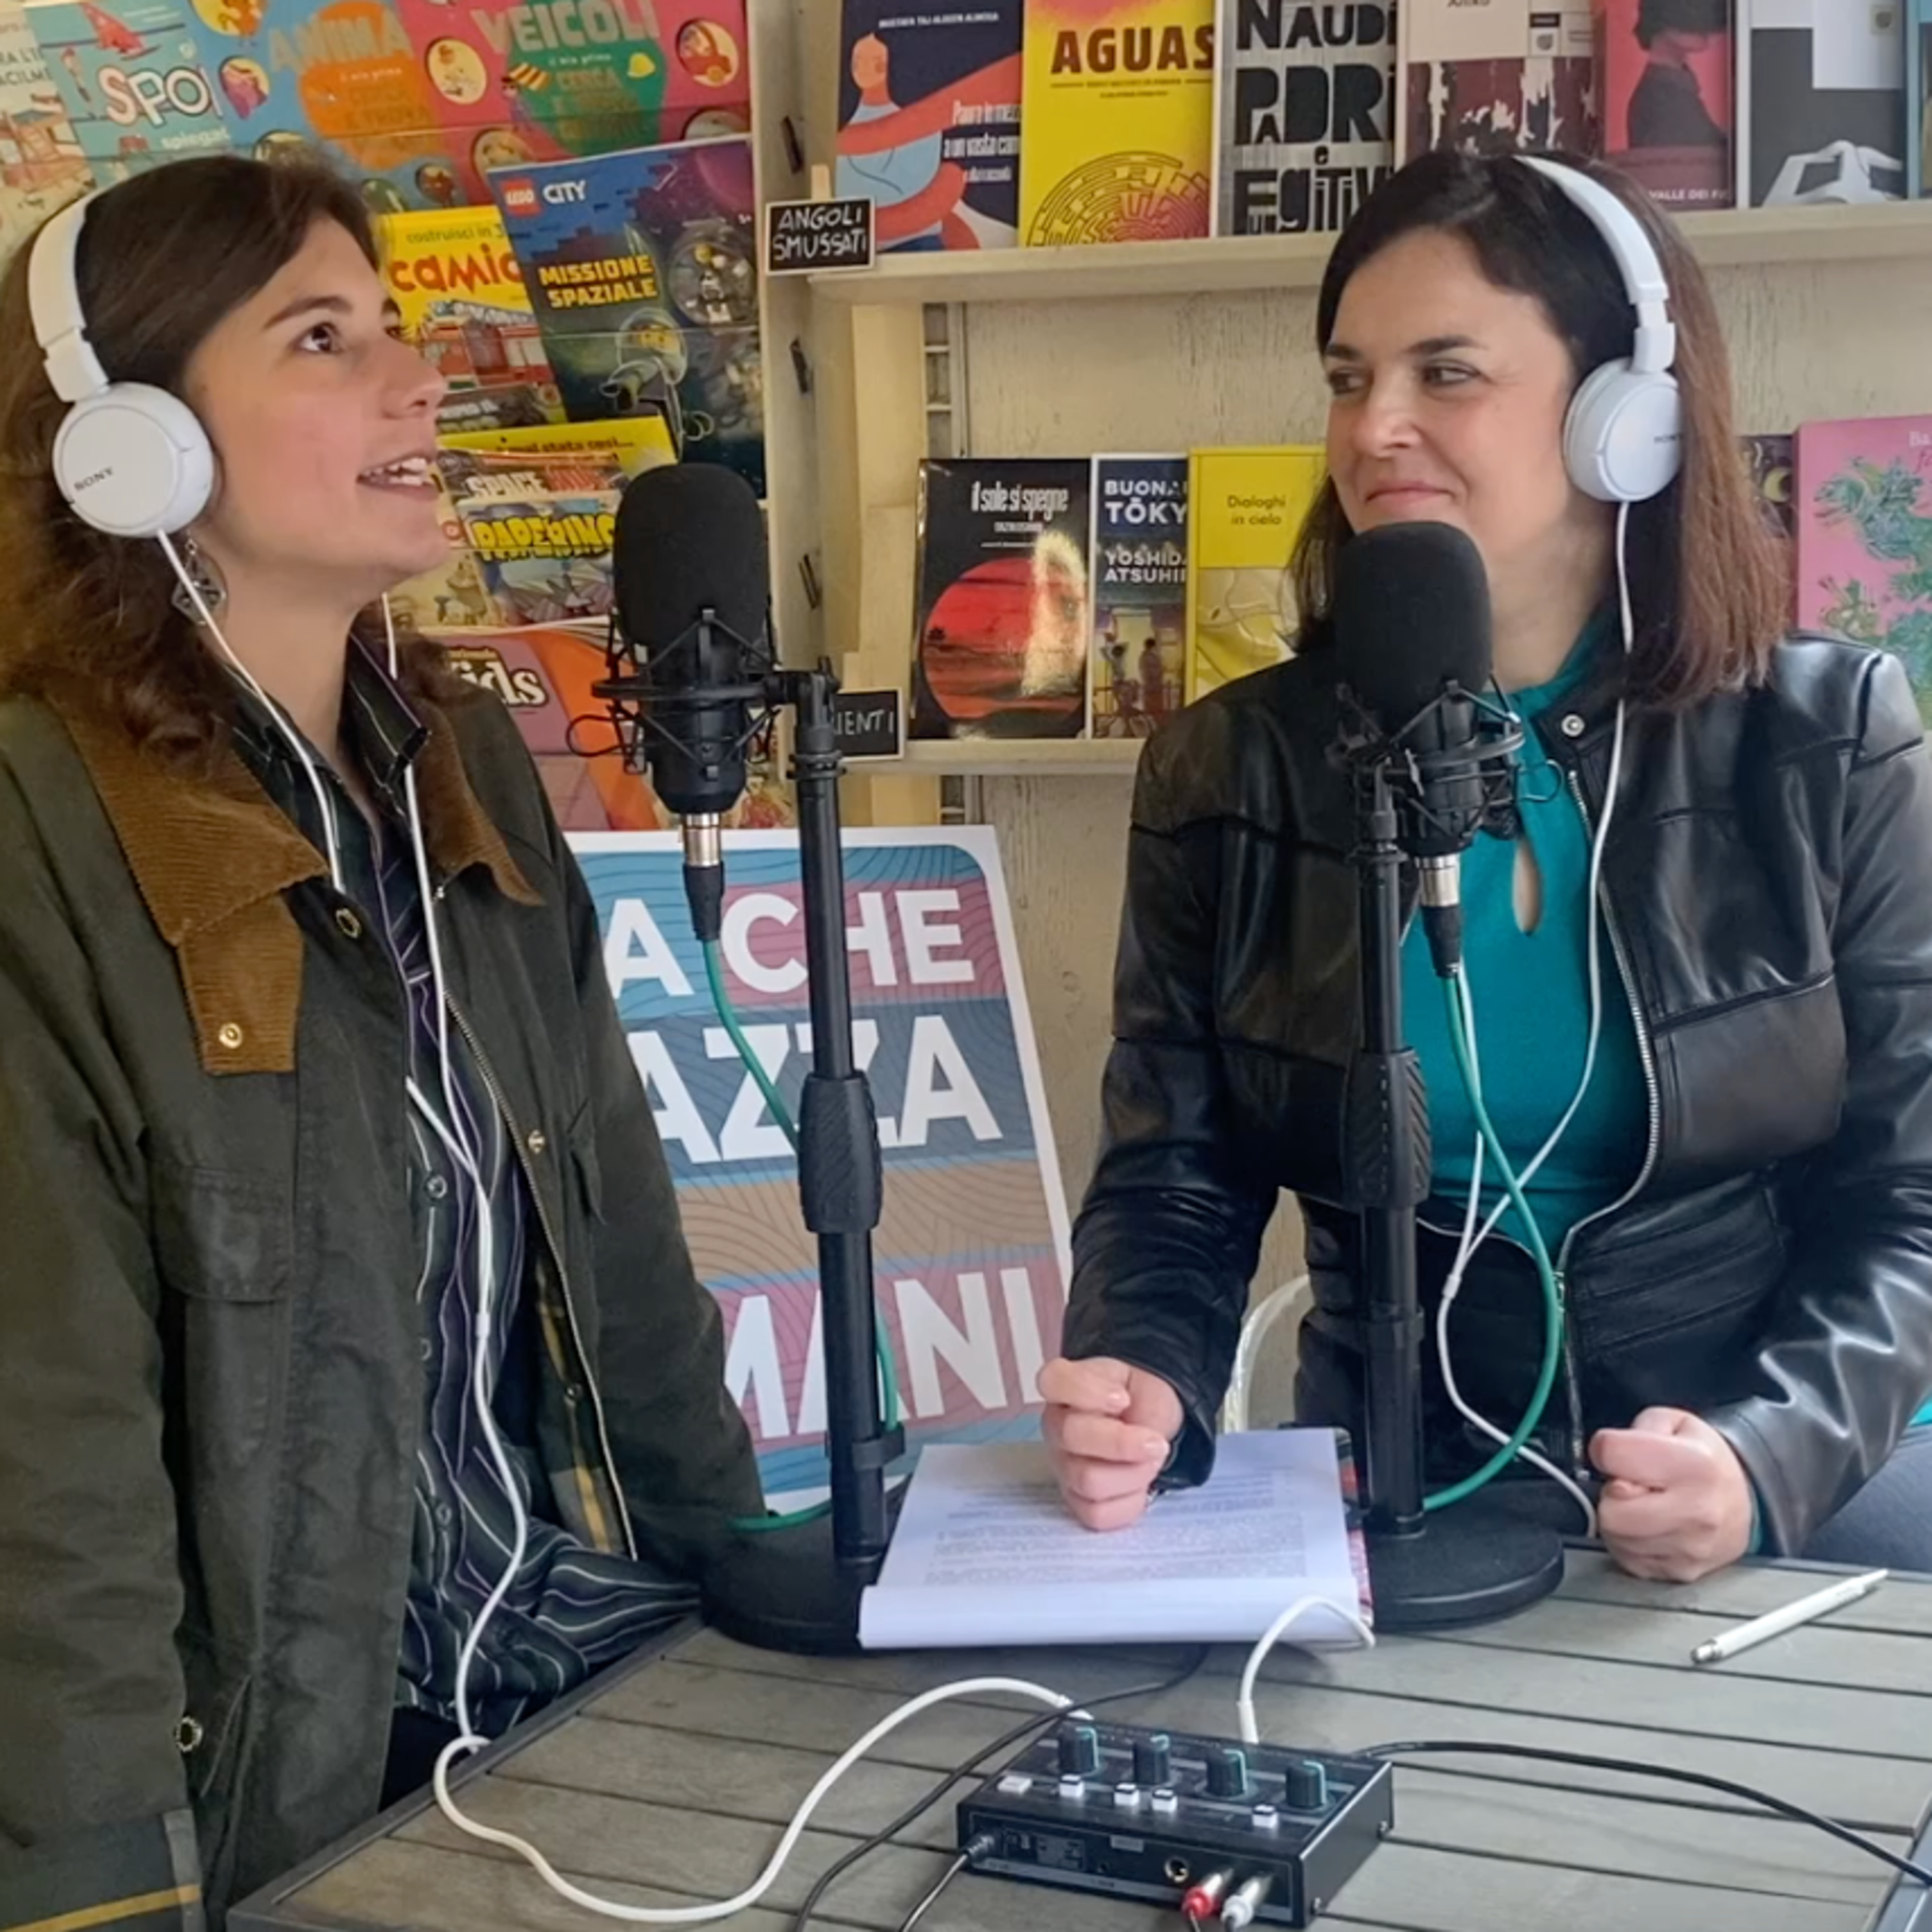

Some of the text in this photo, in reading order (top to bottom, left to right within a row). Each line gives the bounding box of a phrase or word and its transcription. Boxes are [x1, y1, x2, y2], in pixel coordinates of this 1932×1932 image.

[469, 0, 660, 54] VEICOLI
[1050, 24, 1215, 75] AGUAS
[98, 65, 223, 127] SPO
[160, 127, 231, 150] spiegat
[542, 180, 587, 204] CITY
[778, 204, 862, 231] ANGOLI
[773, 228, 867, 261] SMUSSATI
[538, 254, 656, 287] MISSIONE
[547, 278, 659, 310] SPAZIALE
[73, 466, 114, 493] SONY
[1104, 479, 1187, 497] BUON
[1227, 494, 1287, 511] Dialoghi
[1249, 513, 1282, 526] cielo
[1104, 549, 1187, 567] YOSHID
[719, 889, 976, 994] CHE
